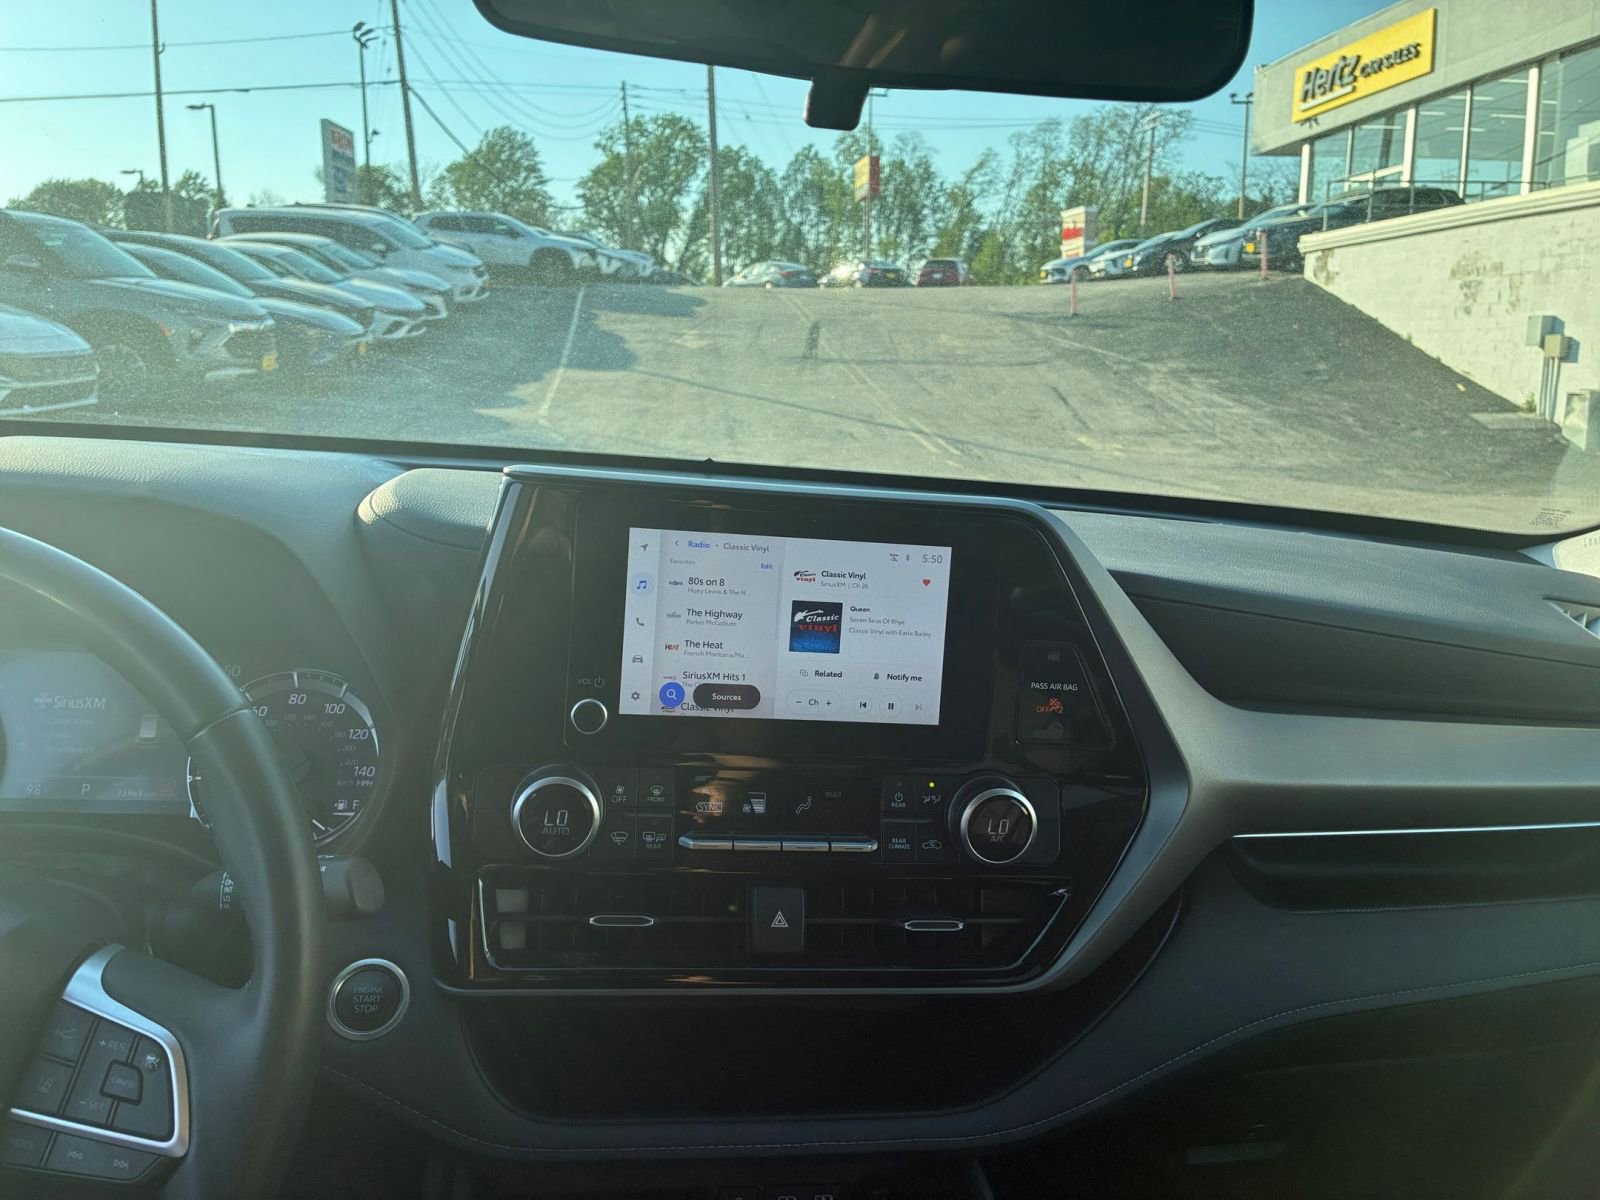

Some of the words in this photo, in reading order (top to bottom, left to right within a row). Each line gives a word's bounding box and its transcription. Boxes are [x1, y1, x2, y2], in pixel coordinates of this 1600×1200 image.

[1301, 55, 1361, 103] Hertz
[688, 540, 710, 549] Radio
[723, 543, 750, 551] Classic
[751, 544, 770, 554] Vinyl
[922, 554, 943, 564] 5:50
[760, 562, 774, 570] Edit
[821, 570, 847, 578] Classic
[848, 572, 866, 580] Vinyl
[688, 577, 704, 586] 80s
[719, 578, 725, 587] 8
[686, 608, 703, 617] The
[704, 609, 743, 620] Highway
[806, 613, 840, 622] Classic
[799, 624, 838, 633] vinyl
[684, 639, 701, 649] The
[702, 640, 723, 650] Heat
[682, 671, 721, 680] SiriusXM
[722, 673, 740, 681] Hits
[814, 669, 843, 678] Related
[886, 673, 909, 682] Notify
[577, 677, 592, 685] VOL
[1030, 682, 1049, 690] PASS
[1062, 683, 1078, 691] BAG
[288, 693, 308, 705] 80
[711, 692, 742, 701] Sources
[53, 696, 107, 710] SiriusXM
[808, 698, 819, 706] Ch
[323, 703, 347, 715] 100
[349, 728, 369, 740] 120
[353, 766, 376, 777] 140
[81, 783, 91, 796] P
[611, 795, 627, 803] OFF
[352, 799, 361, 810] F
[698, 803, 722, 811] SYNC
[542, 826, 570, 835] AUTO
[352, 985, 383, 994] ENGINE
[352, 994, 382, 1004] START
[353, 1004, 379, 1014] STOP
